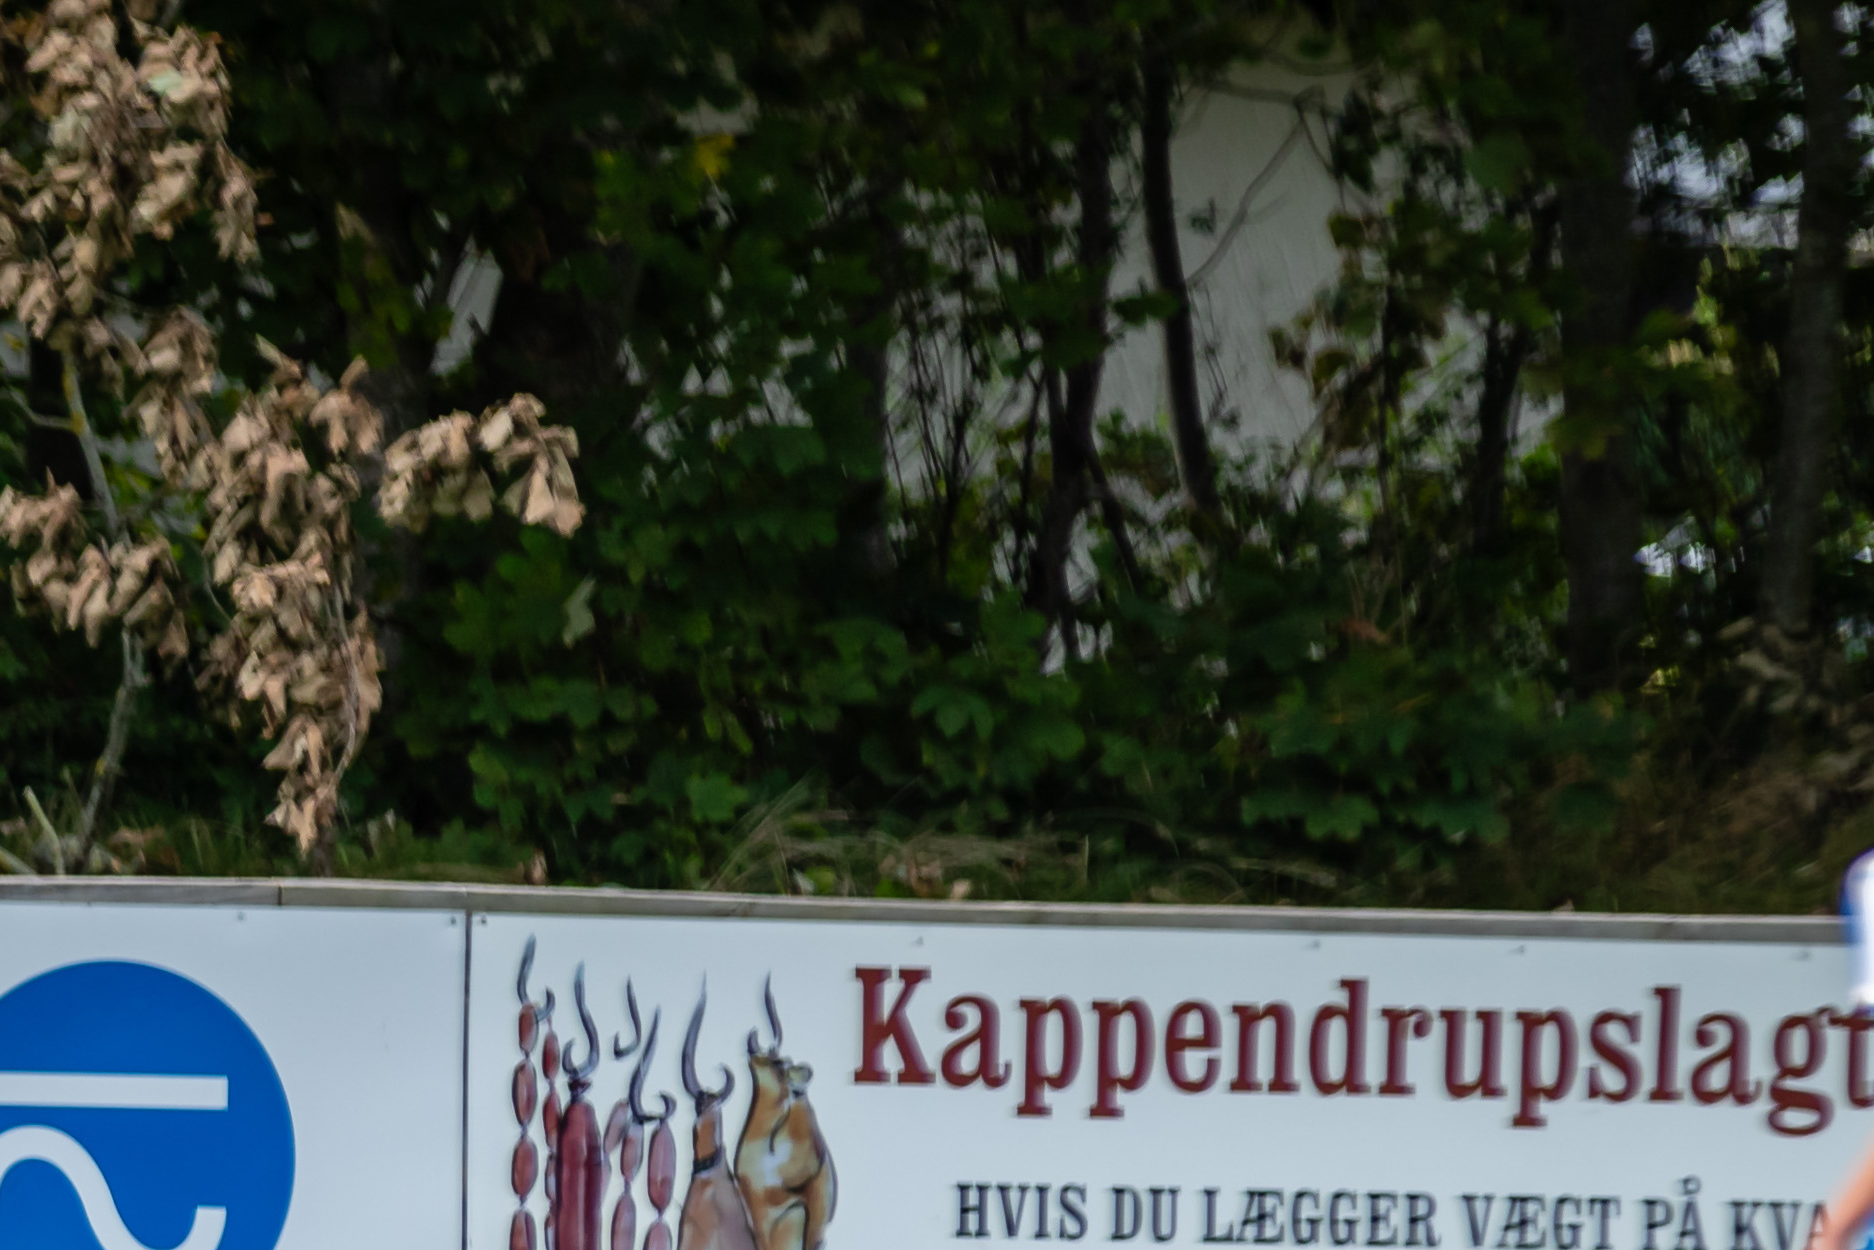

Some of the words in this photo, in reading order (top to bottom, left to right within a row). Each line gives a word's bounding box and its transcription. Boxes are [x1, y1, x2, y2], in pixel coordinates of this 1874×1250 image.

[955, 1182, 1088, 1241] HVIS
[1110, 1186, 1180, 1244] DU
[1202, 1188, 1439, 1248] LÆGGER
